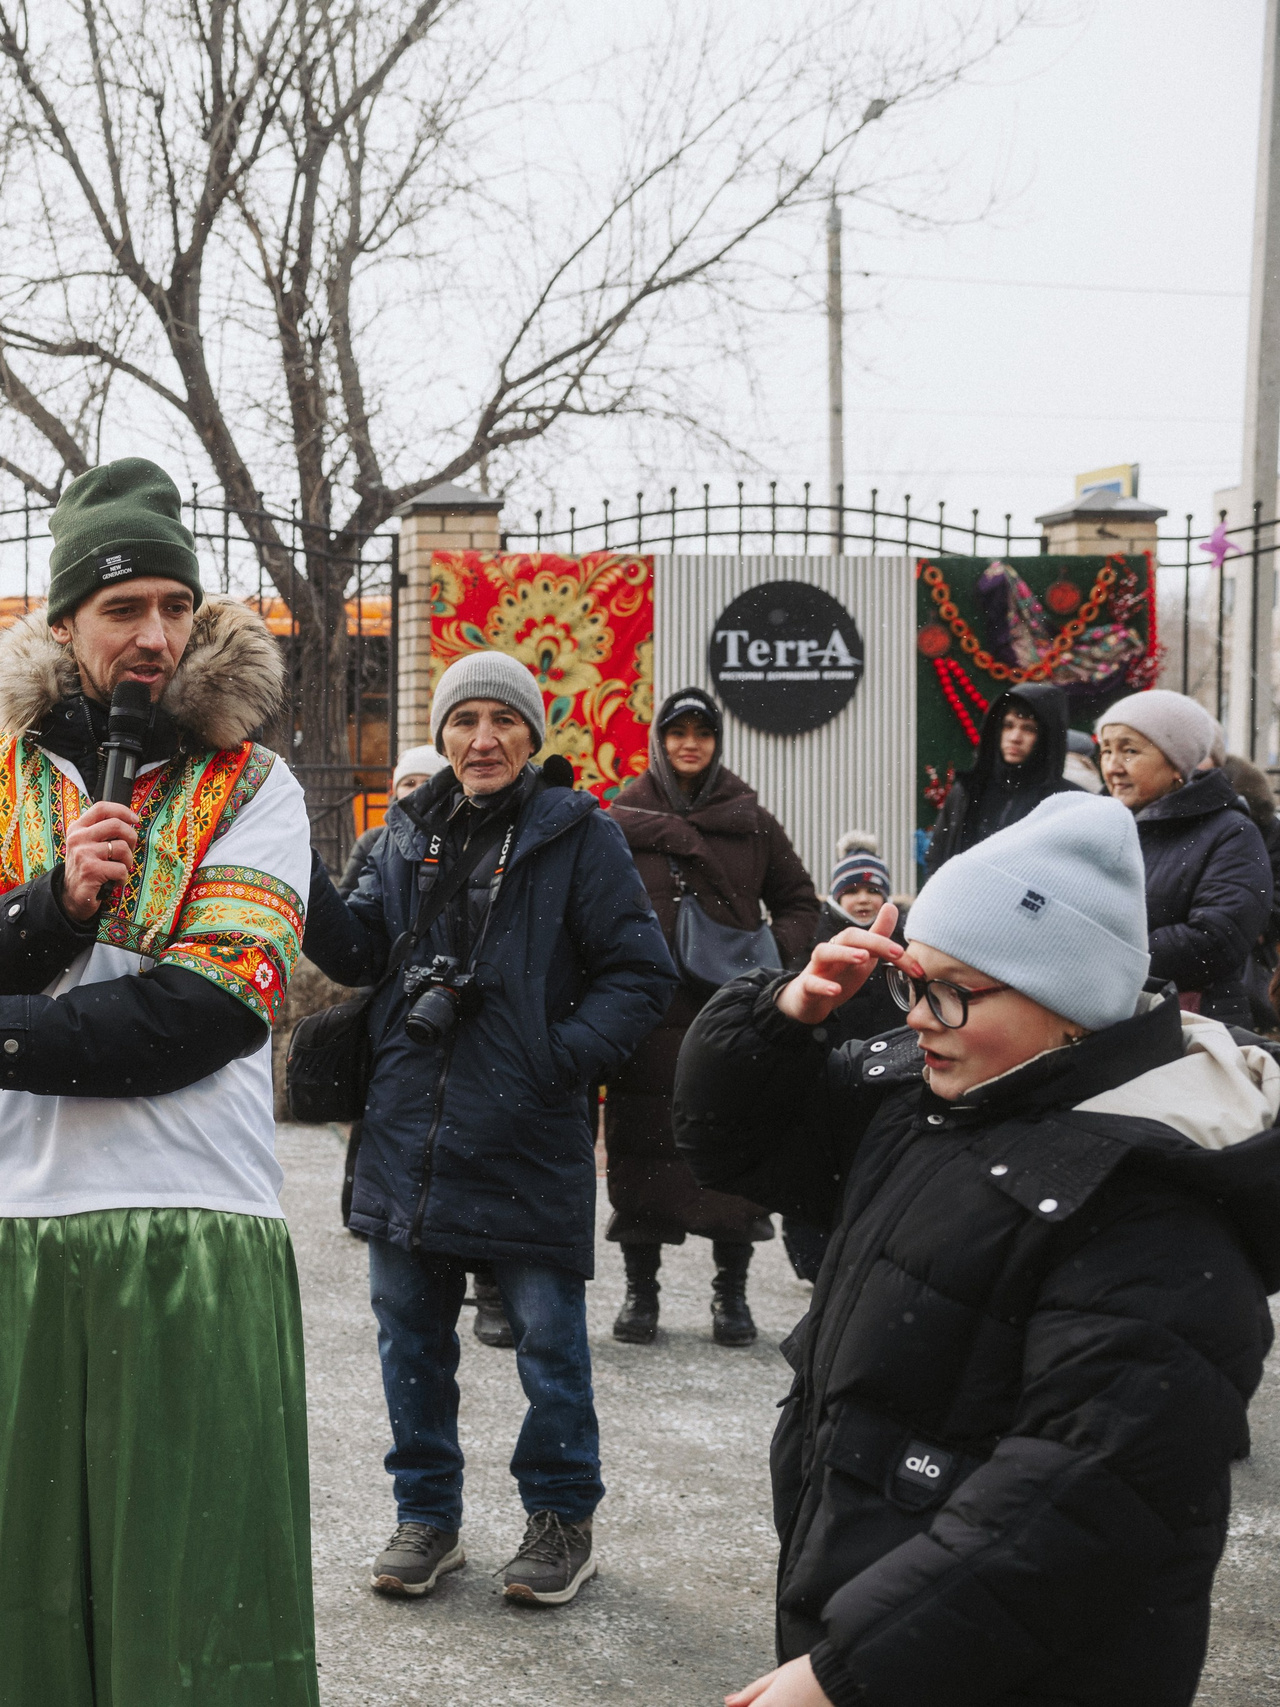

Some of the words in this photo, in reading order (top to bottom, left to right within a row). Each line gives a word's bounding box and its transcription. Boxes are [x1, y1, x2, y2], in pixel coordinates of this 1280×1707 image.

[102, 567, 133, 580] GENERATION
[109, 564, 122, 572] NEW
[716, 629, 862, 667] TerrA
[499, 824, 514, 866] SONY
[1020, 897, 1042, 913] BEST
[905, 1454, 941, 1478] alo
